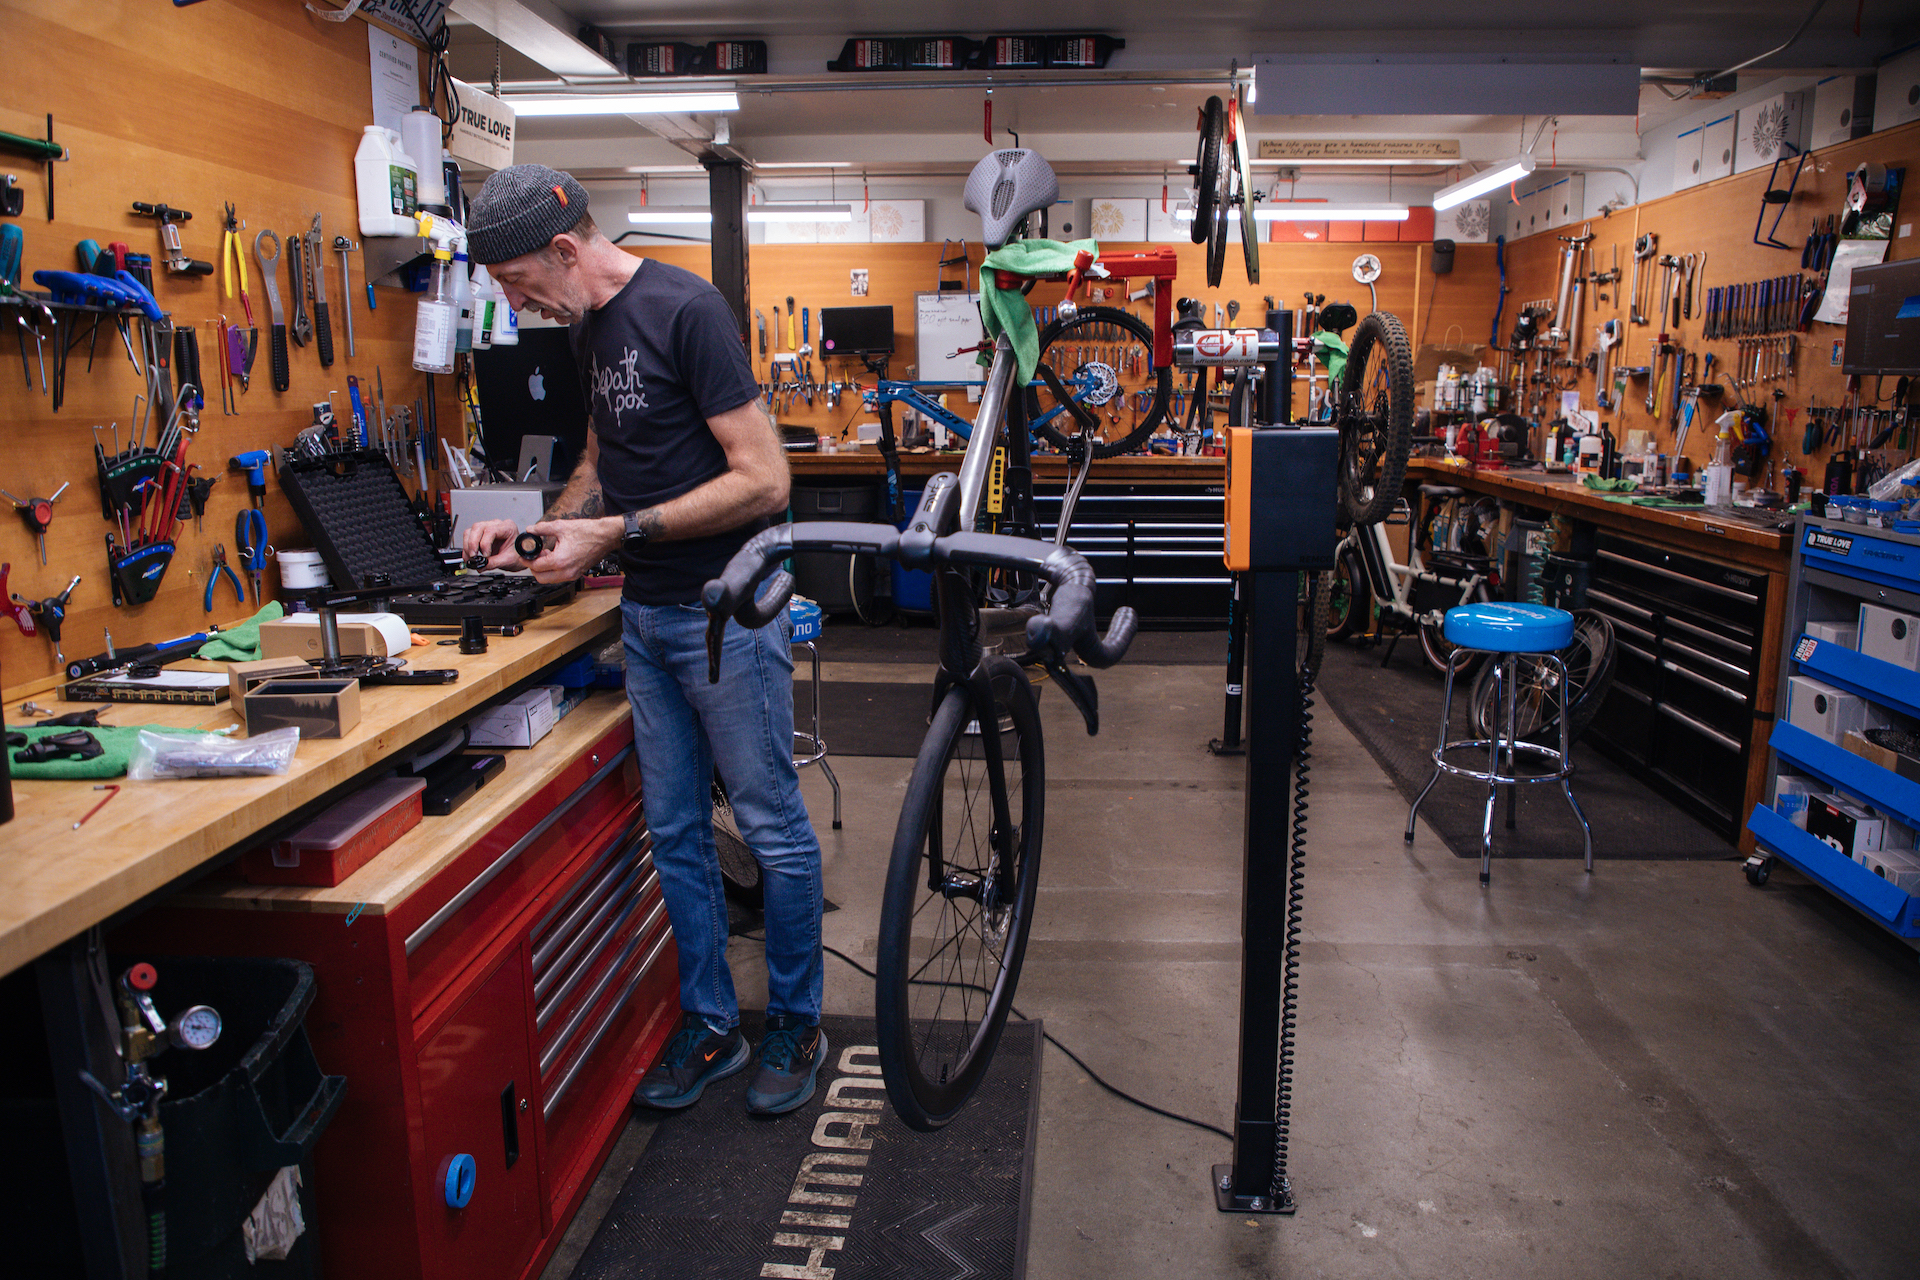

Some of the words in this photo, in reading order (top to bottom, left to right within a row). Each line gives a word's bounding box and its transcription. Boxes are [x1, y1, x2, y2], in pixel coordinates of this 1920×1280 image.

[461, 106, 486, 132] TRUE
[488, 118, 511, 141] LOVE
[1286, 141, 1300, 149] life
[1290, 148, 1304, 156] life
[1060, 312, 1096, 328] MXXIS
[1816, 534, 1834, 546] TRUE
[1834, 538, 1852, 549] LOVE
[1730, 574, 1752, 587] HUSKY
[1795, 638, 1809, 660] SHOX
[1804, 639, 1817, 662] ROCK
